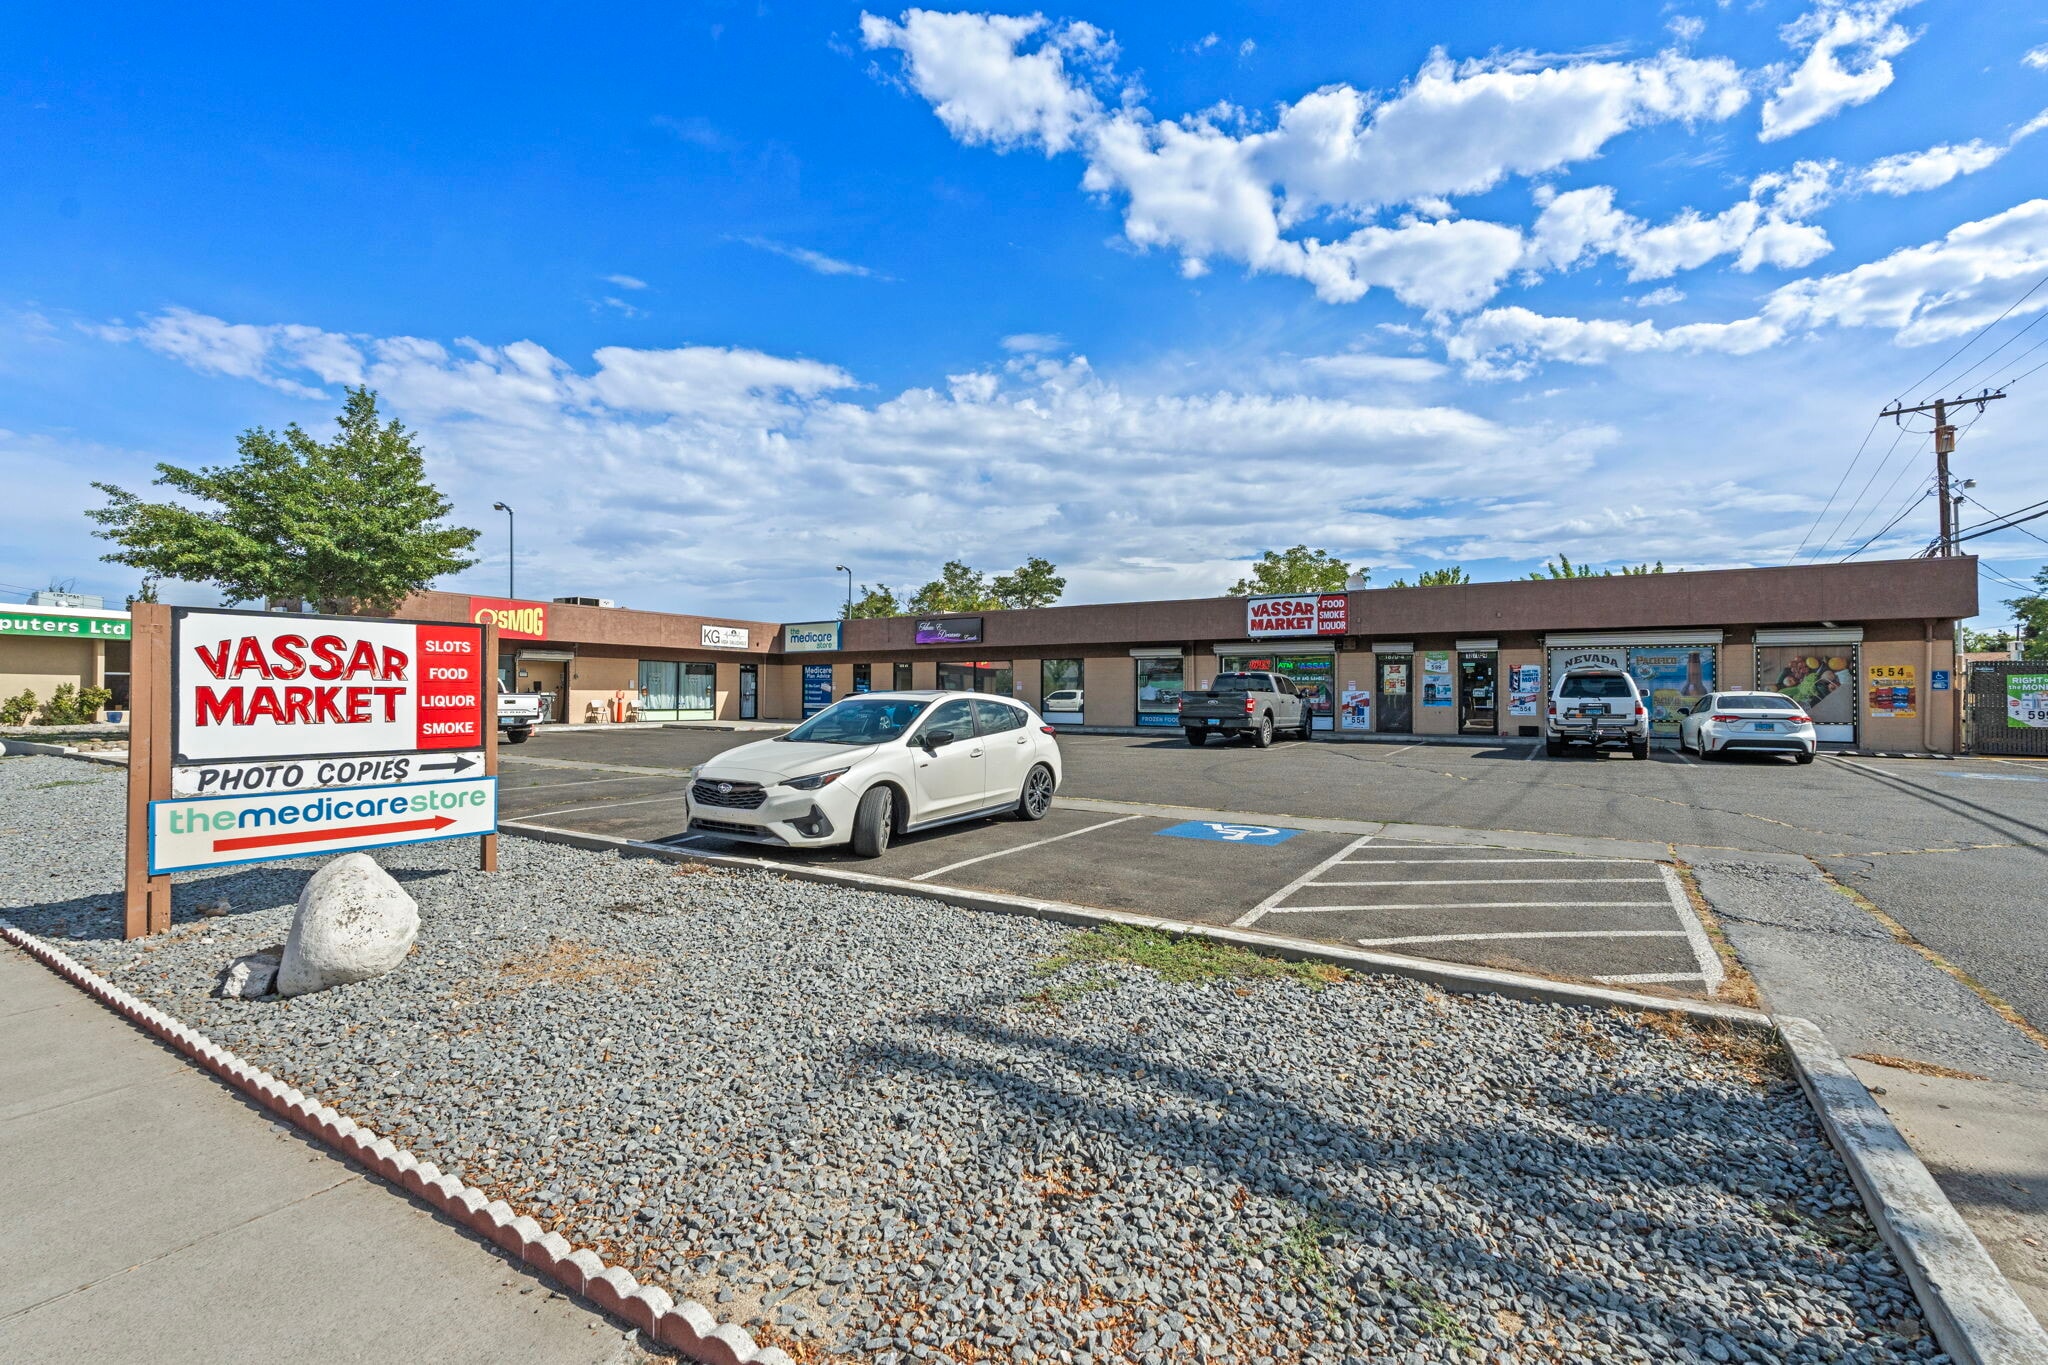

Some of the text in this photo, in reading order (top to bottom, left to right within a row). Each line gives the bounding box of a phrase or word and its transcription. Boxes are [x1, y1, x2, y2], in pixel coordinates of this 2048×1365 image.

[1251, 601, 1314, 617] VASSAR
[1322, 600, 1344, 608] FOOD
[1320, 611, 1345, 619] SMOKE
[90, 620, 126, 635] Ltd
[1251, 617, 1314, 631] MARKET
[1320, 621, 1346, 630] LIQUOR
[703, 629, 720, 644] KG
[790, 632, 832, 643] medicare
[425, 640, 471, 653] SLOTS
[194, 634, 408, 681] VASSAR
[1565, 654, 1619, 669] NEVADA
[429, 668, 468, 680] FOOD
[804, 666, 832, 674] Medicare
[194, 685, 407, 727] MARKET
[421, 694, 475, 708] LIQUOR
[1351, 716, 1365, 724] 554
[422, 722, 474, 735] SMOKE
[197, 758, 411, 792] PHOTO COPIES
